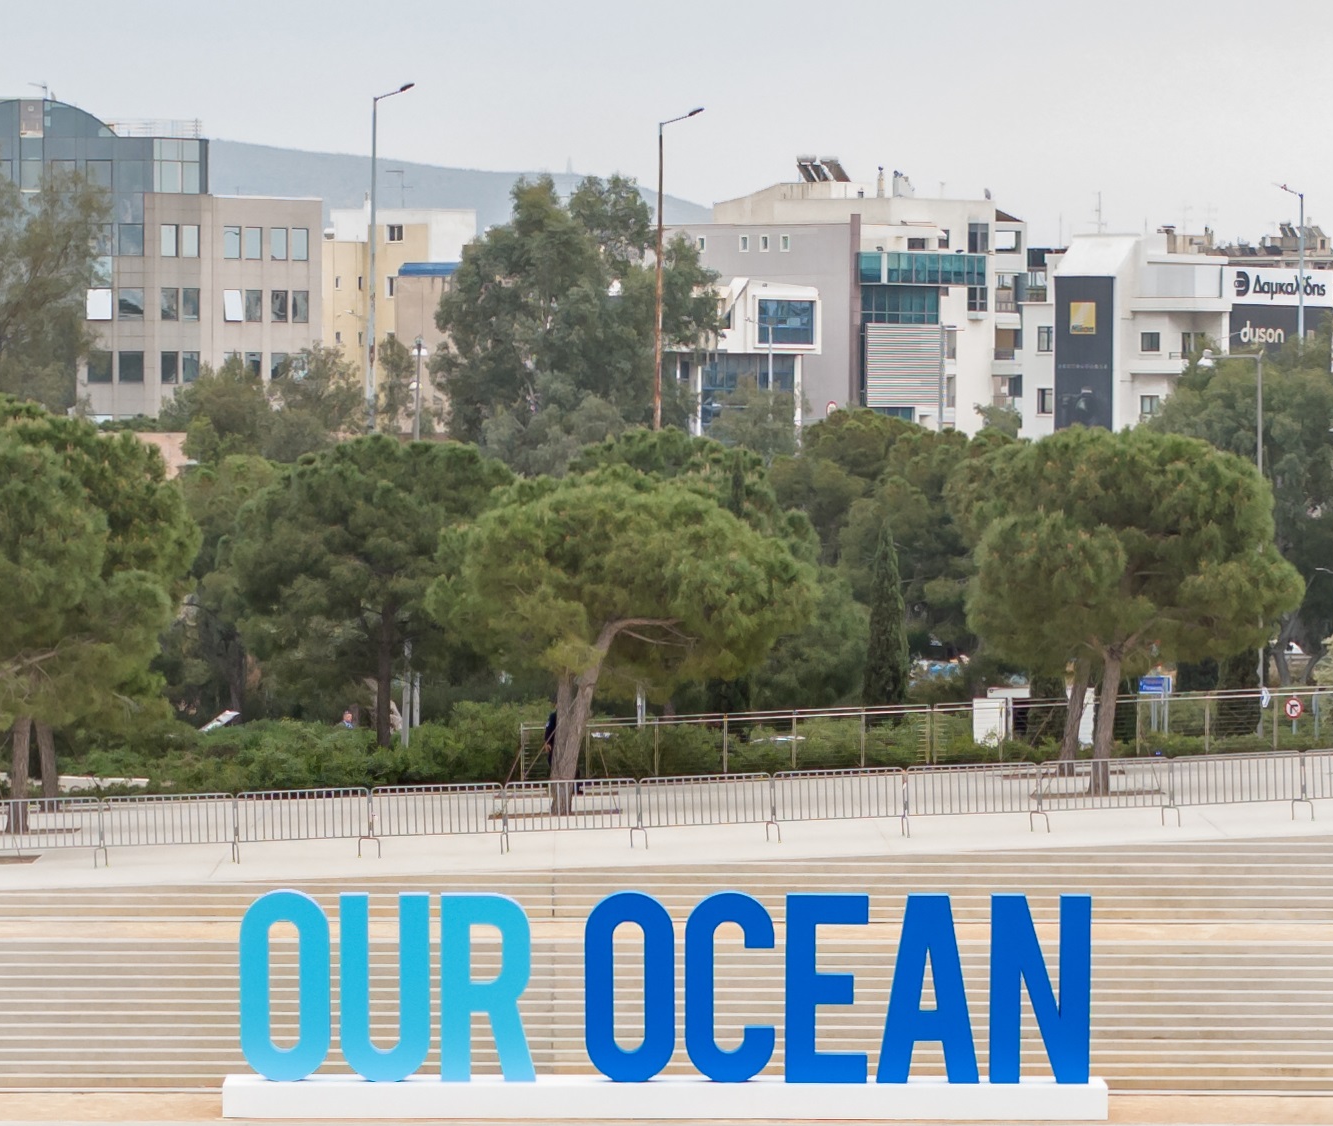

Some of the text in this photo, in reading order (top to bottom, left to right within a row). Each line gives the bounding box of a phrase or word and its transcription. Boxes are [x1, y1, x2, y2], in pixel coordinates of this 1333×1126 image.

[1253, 274, 1326, 300] Δαμκαλδης
[239, 888, 1091, 1083] OUR OCEAN
